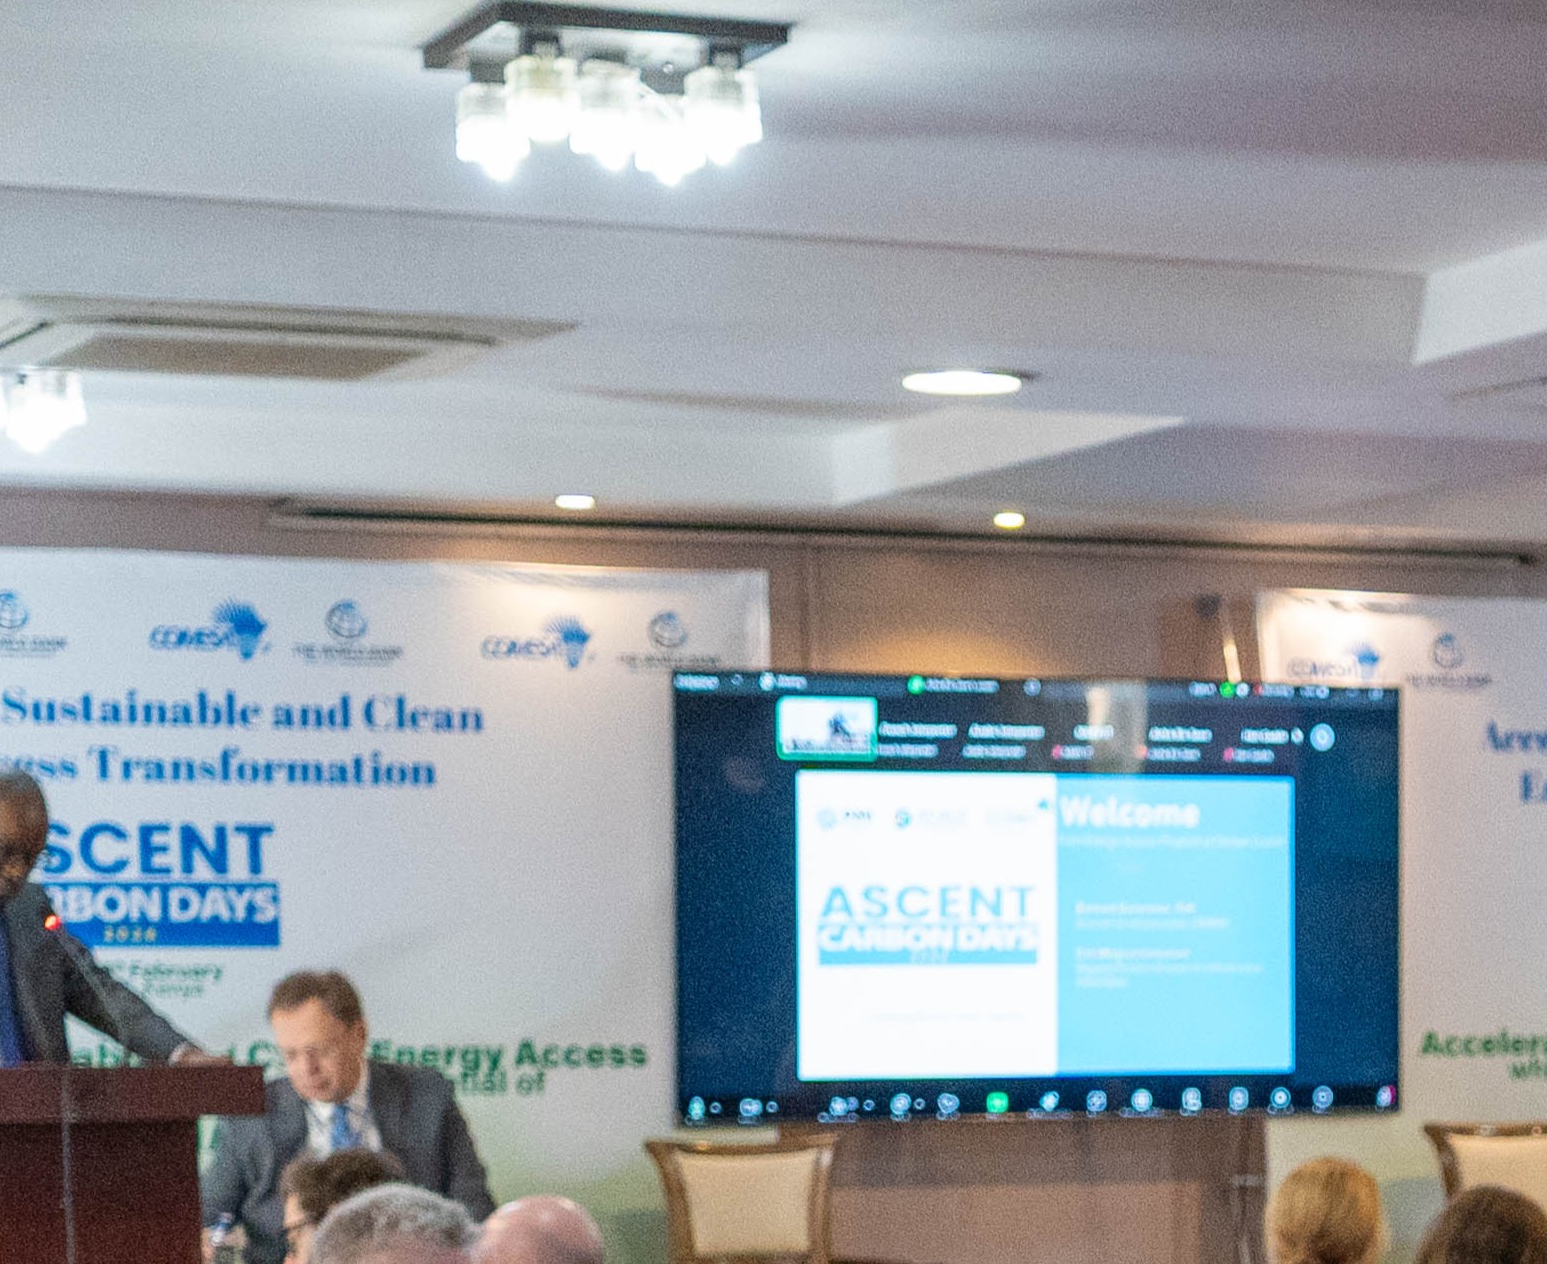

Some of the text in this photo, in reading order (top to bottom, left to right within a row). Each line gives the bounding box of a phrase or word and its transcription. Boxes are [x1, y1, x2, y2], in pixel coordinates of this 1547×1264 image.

[32, 636, 68, 648] BANK
[149, 625, 238, 651] COMESA
[480, 635, 565, 660] COMESA
[0, 685, 262, 728] Sustainable
[272, 692, 352, 731] and
[362, 692, 485, 733] Clean
[87, 744, 436, 787] Transformation
[1059, 797, 1201, 829] Welcome
[43, 822, 274, 876] SCENT
[167, 885, 279, 924] DAYS
[820, 885, 1037, 918] ASCENT
[818, 924, 952, 952] CARBON
[370, 1040, 650, 1078] Energy Access
